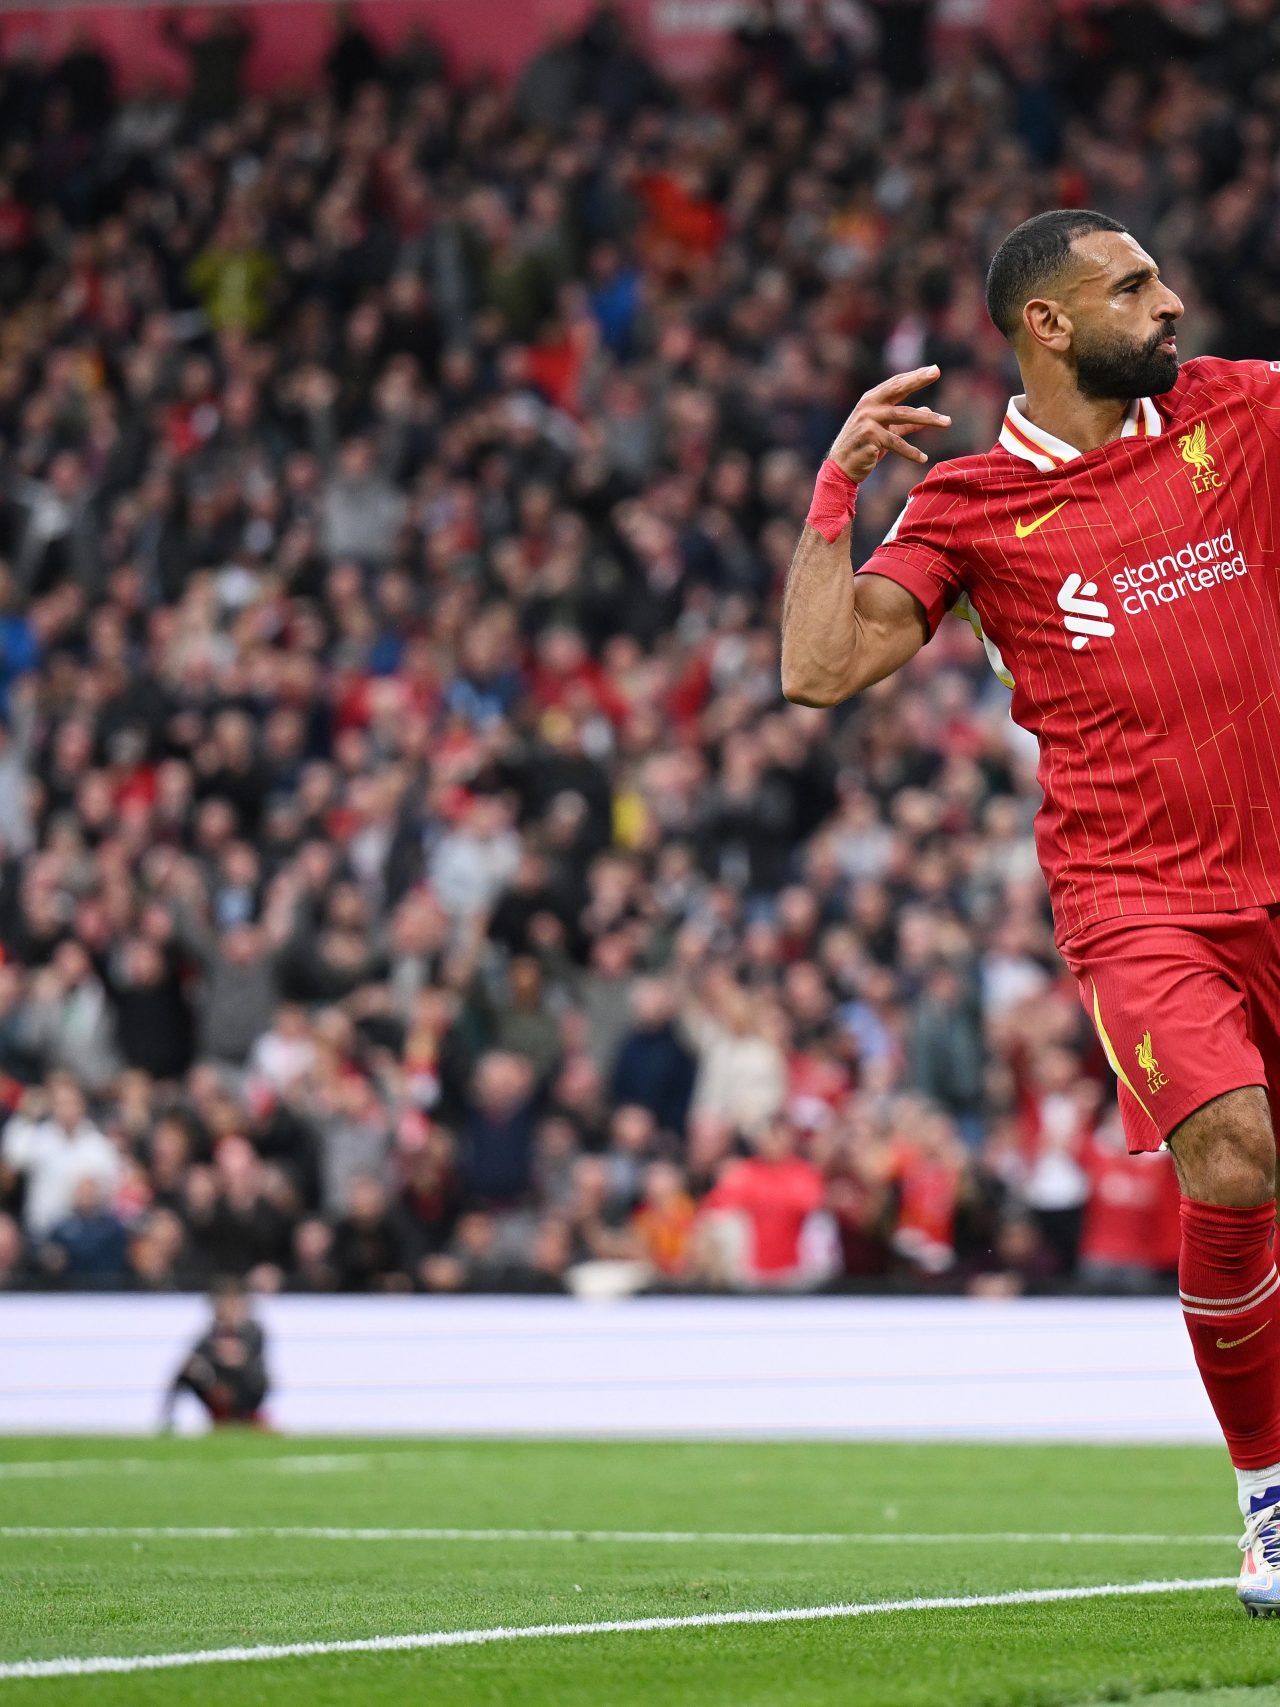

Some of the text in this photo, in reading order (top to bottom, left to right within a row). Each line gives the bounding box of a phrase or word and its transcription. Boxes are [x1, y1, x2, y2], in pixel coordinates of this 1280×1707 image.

[1192, 473, 1226, 494] L.F.C.
[1113, 528, 1235, 593] standard
[1123, 551, 1248, 614] chartered
